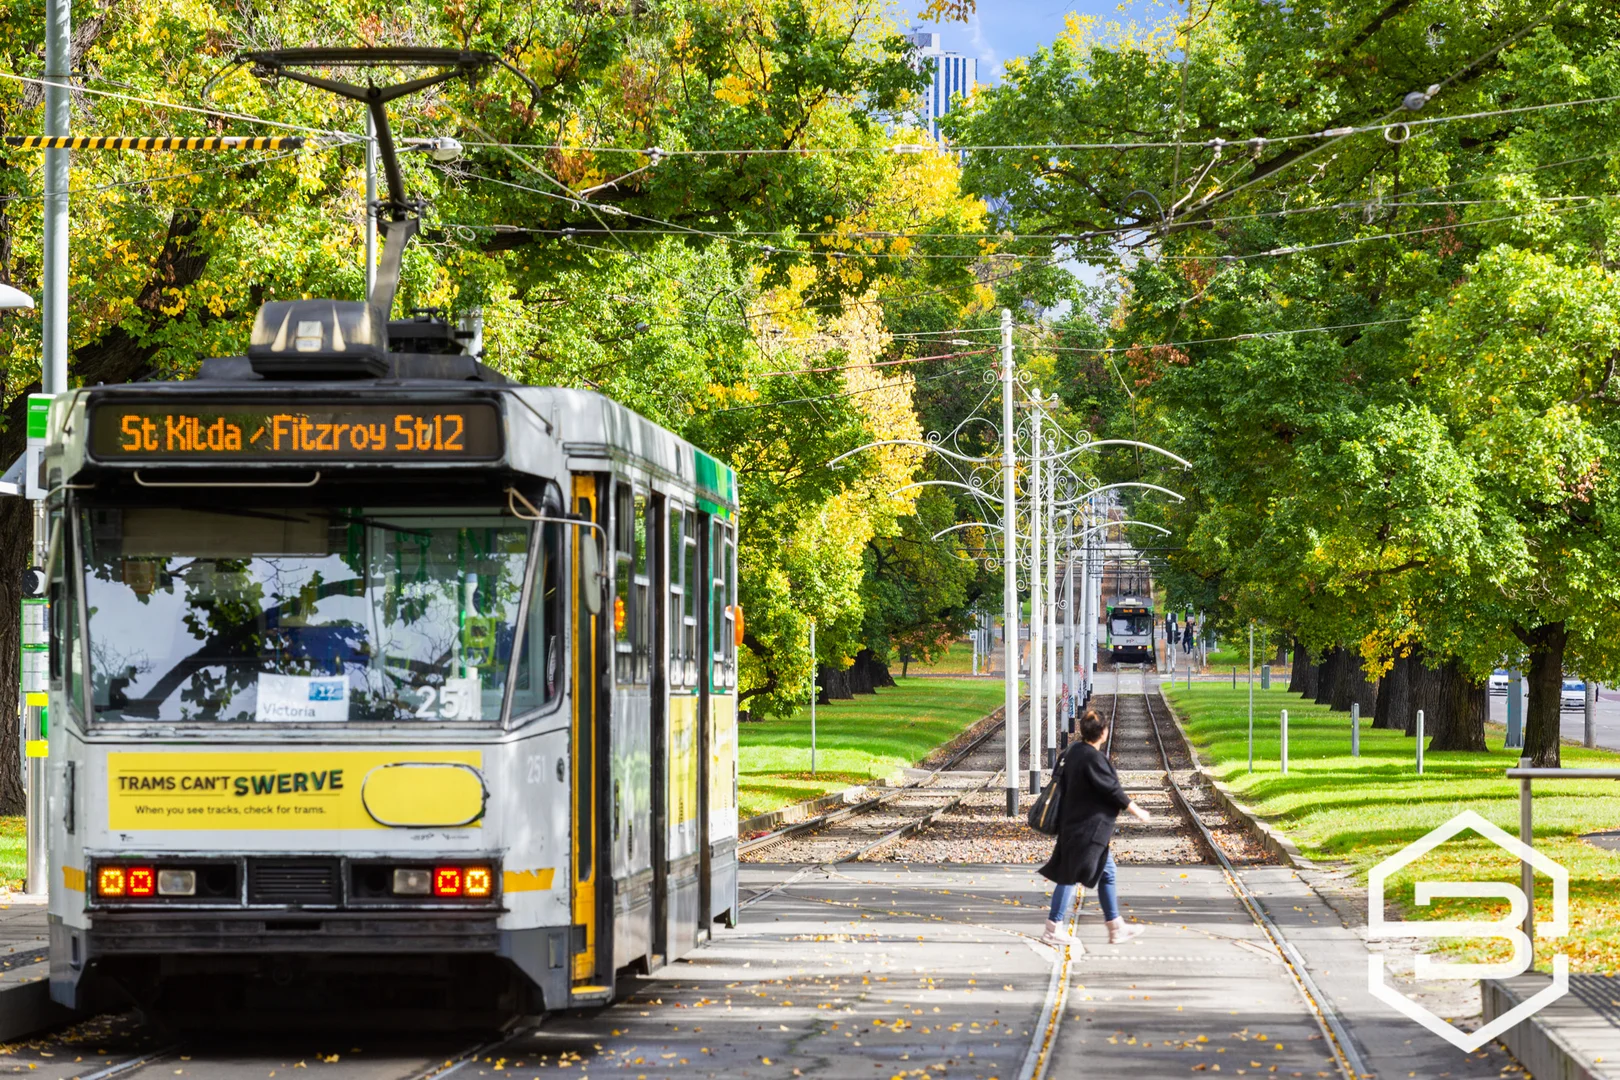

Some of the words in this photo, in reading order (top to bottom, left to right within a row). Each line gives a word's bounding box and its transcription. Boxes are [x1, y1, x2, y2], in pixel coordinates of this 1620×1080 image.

[121, 414, 157, 451] St
[166, 414, 242, 451] Kilda
[272, 413, 386, 451] Fitzroy
[263, 703, 316, 717] Victoria
[118, 776, 176, 790] TRAMS
[181, 776, 231, 790] CAN'T
[234, 769, 344, 797] SWERVE
[135, 805, 164, 814] When
[167, 806, 185, 817] you
[187, 806, 204, 814] see
[207, 805, 242, 816] tracks,
[244, 805, 274, 814] check
[276, 805, 291, 814] for
[294, 805, 327, 814] trams.
